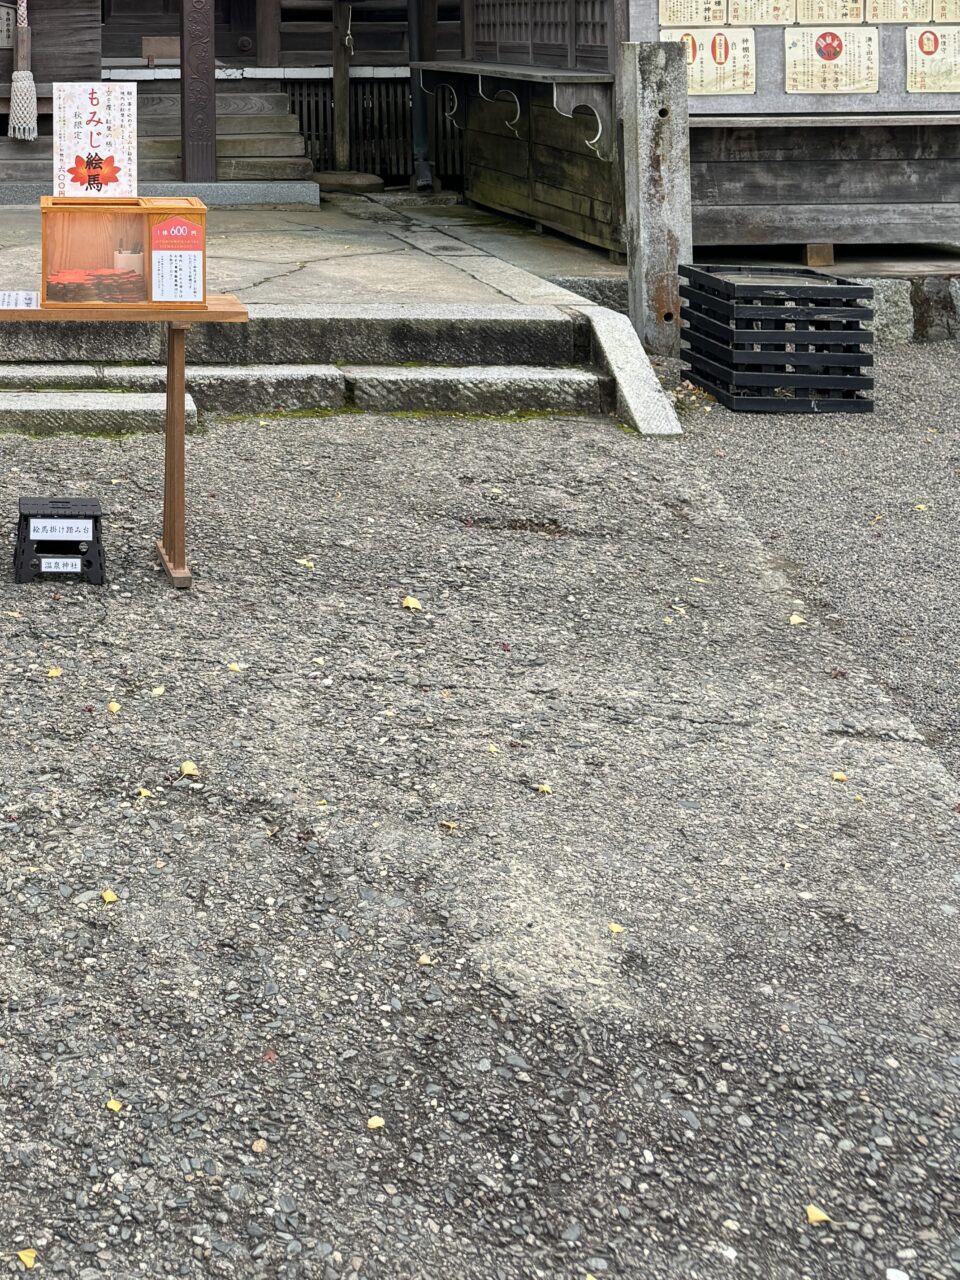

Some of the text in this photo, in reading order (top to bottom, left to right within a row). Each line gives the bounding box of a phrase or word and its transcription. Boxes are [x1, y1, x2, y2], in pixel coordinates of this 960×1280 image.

[85, 88, 104, 192] もみじ絵馬
[32, 525, 89, 534] 絵馬掛け踏み台
[44, 561, 78, 569] 温泉神社
